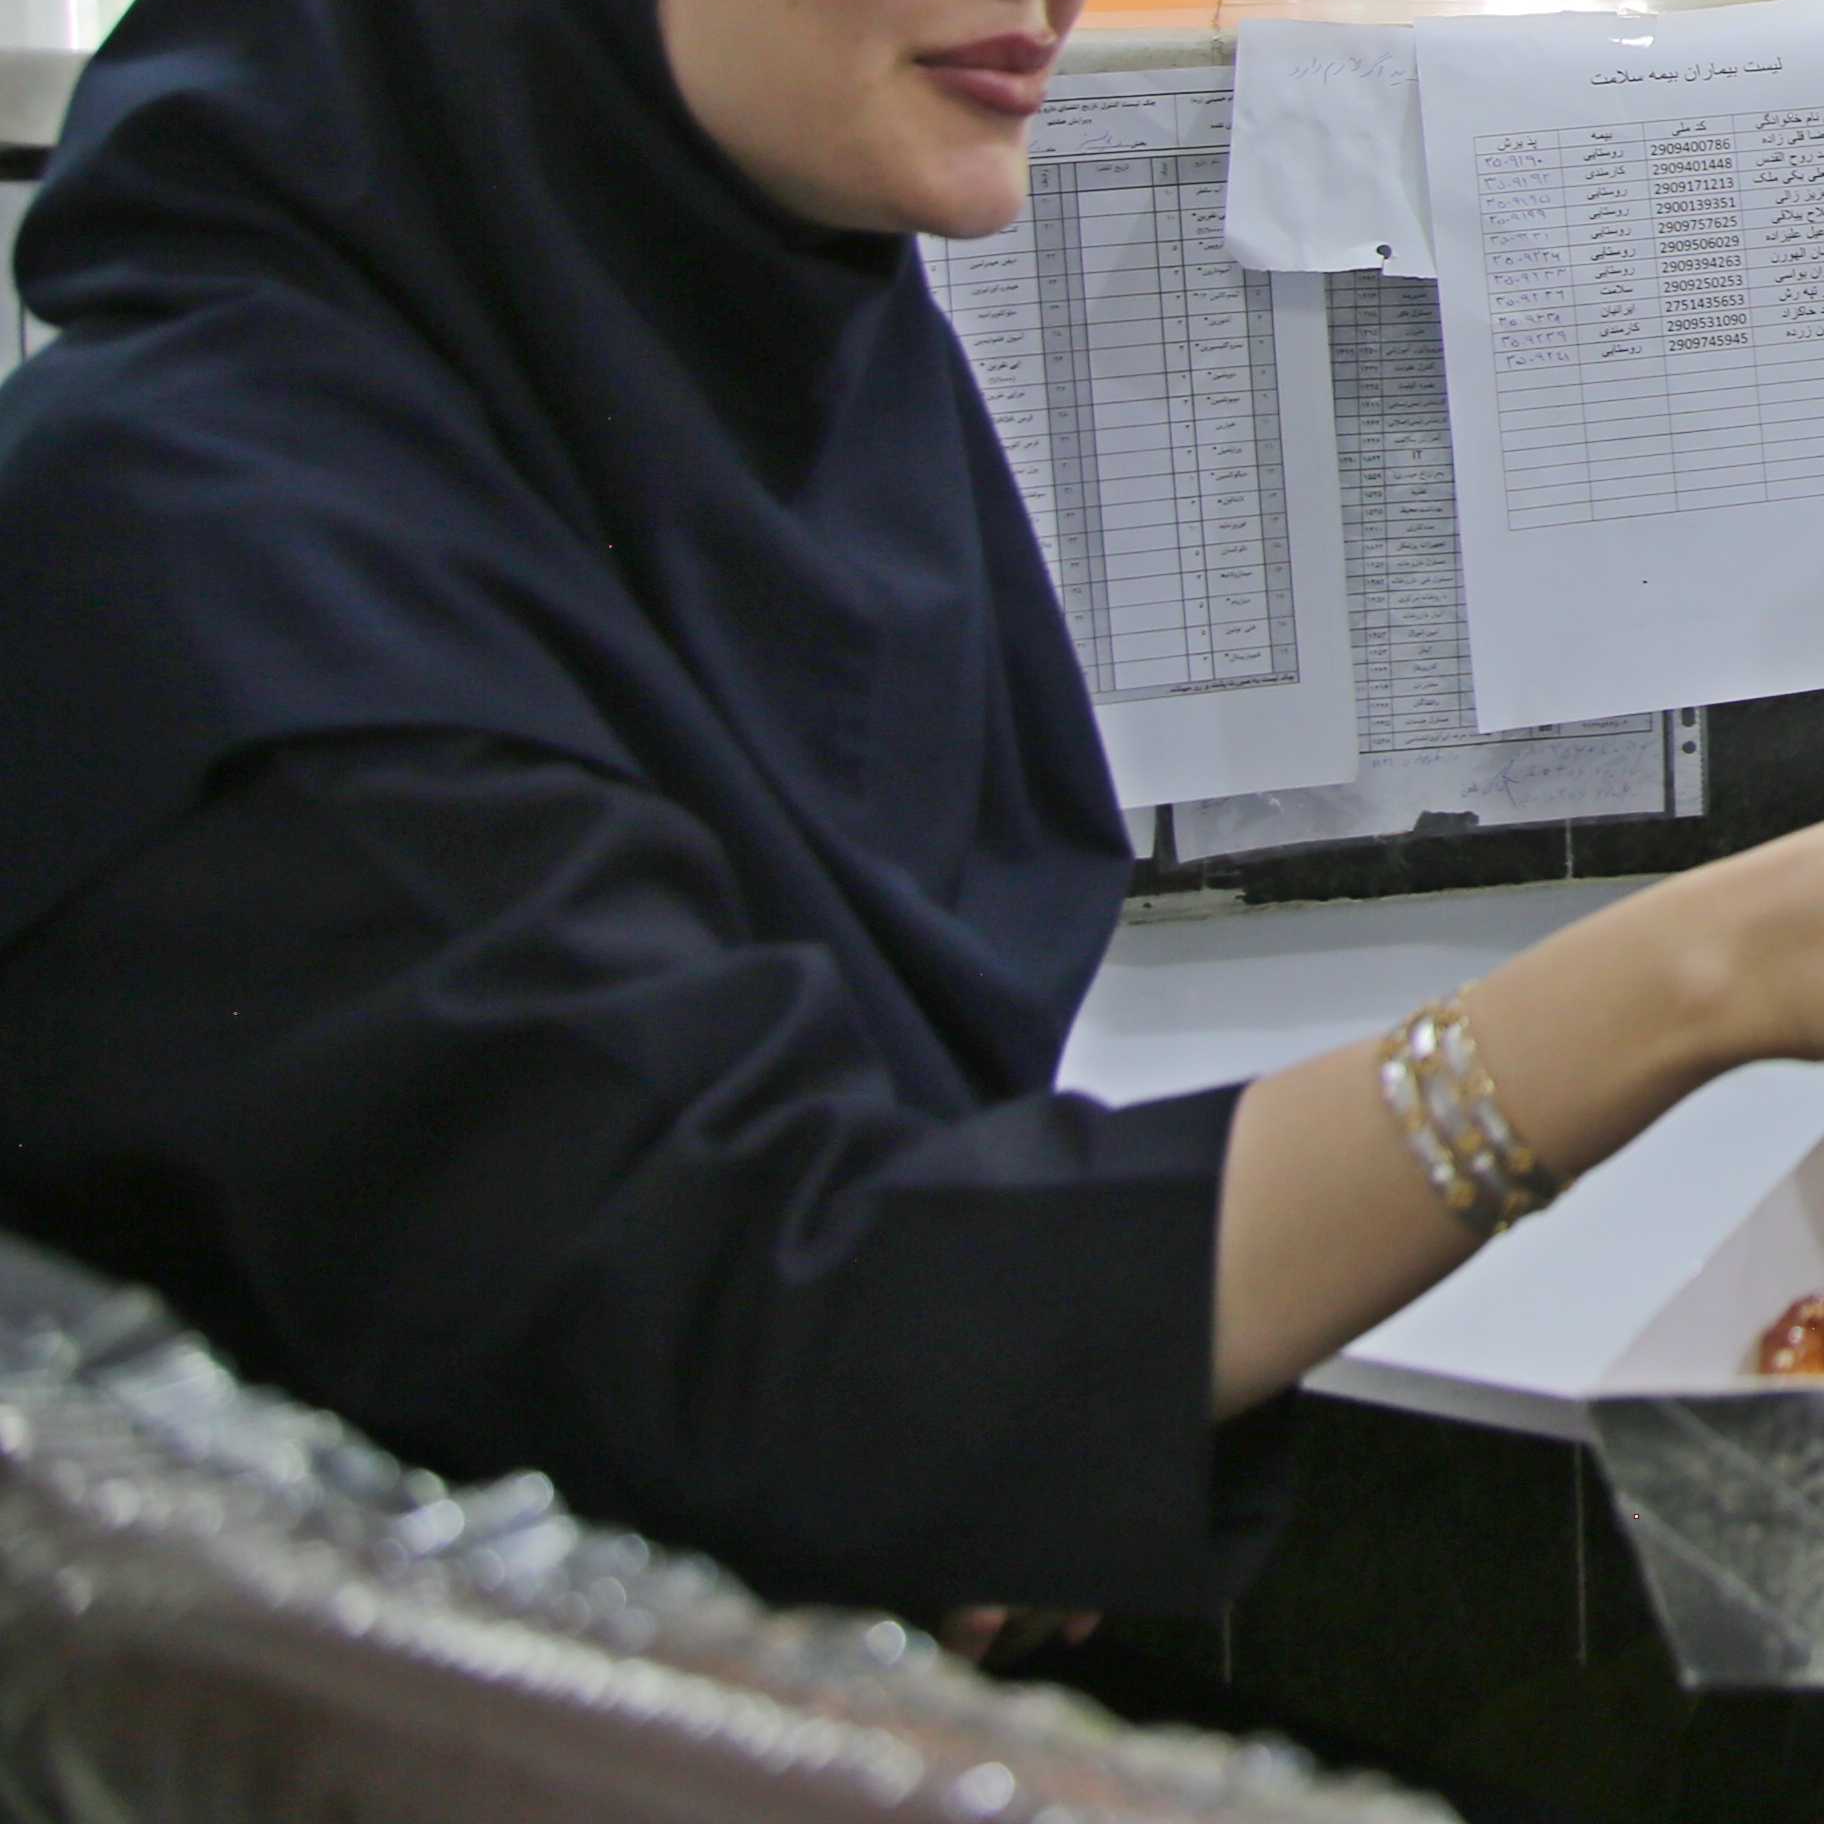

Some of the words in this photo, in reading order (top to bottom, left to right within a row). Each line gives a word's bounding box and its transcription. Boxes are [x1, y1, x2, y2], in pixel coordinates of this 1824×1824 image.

[1684, 62, 1738, 82] بیماران
[1743, 57, 1783, 75] لیست
[1590, 69, 1644, 86] سلامت
[1649, 69, 1679, 84] بیمه
[1650, 138, 1731, 157] 2909400786
[1652, 157, 1733, 176] 2909401448
[1654, 176, 1735, 196] 2909171213
[1656, 196, 1737, 215] 2900139351
[1658, 215, 1738, 235] 2909757625
[1659, 235, 1740, 254] 2909506029
[1661, 254, 1742, 274] 2909394263
[1663, 274, 1744, 294] 2909250253
[1665, 293, 1745, 313] 2751435653
[1666, 312, 1747, 333] 2909531090
[1668, 332, 1749, 352] 2909745945
